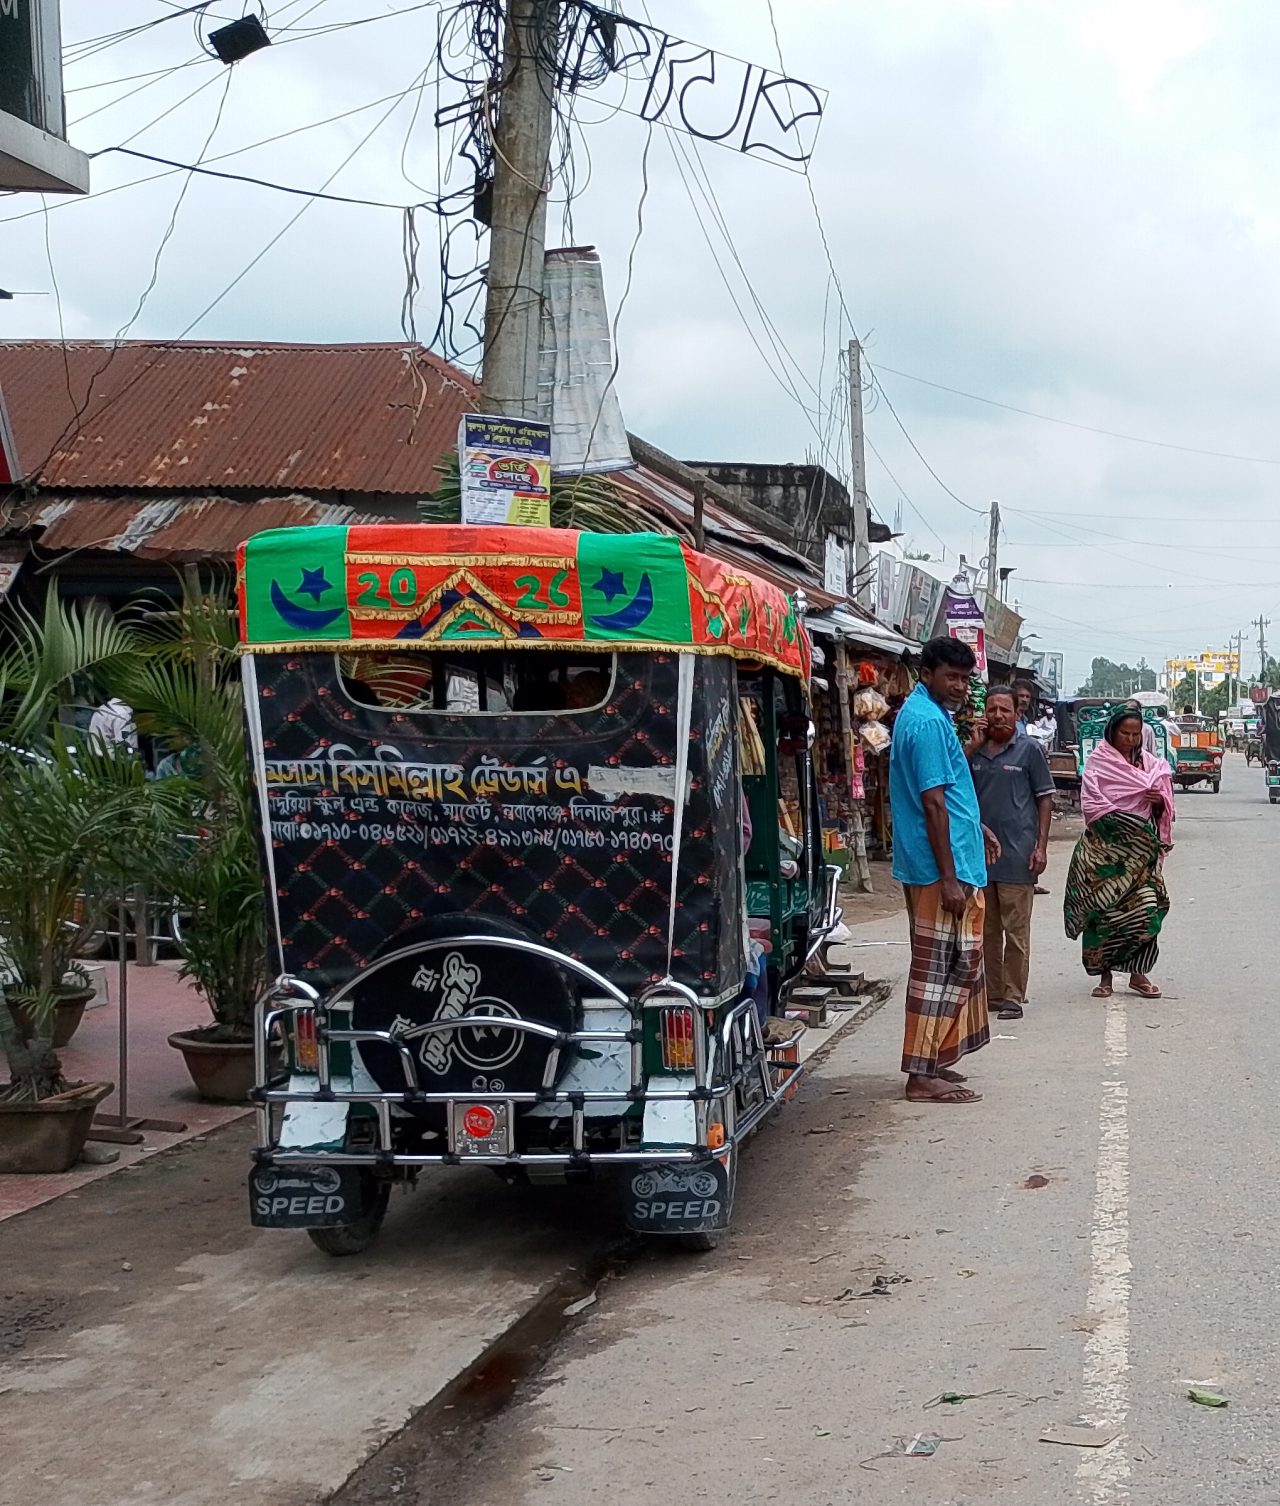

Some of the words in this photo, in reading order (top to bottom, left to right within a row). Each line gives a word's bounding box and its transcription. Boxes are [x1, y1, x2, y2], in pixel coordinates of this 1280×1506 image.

[357, 567, 418, 609] 20
[513, 568, 571, 610] 26
[325, 743, 469, 802] বিসমিল্লাহ
[256, 1195, 345, 1215] SPEED
[633, 1199, 721, 1220] SPEED
